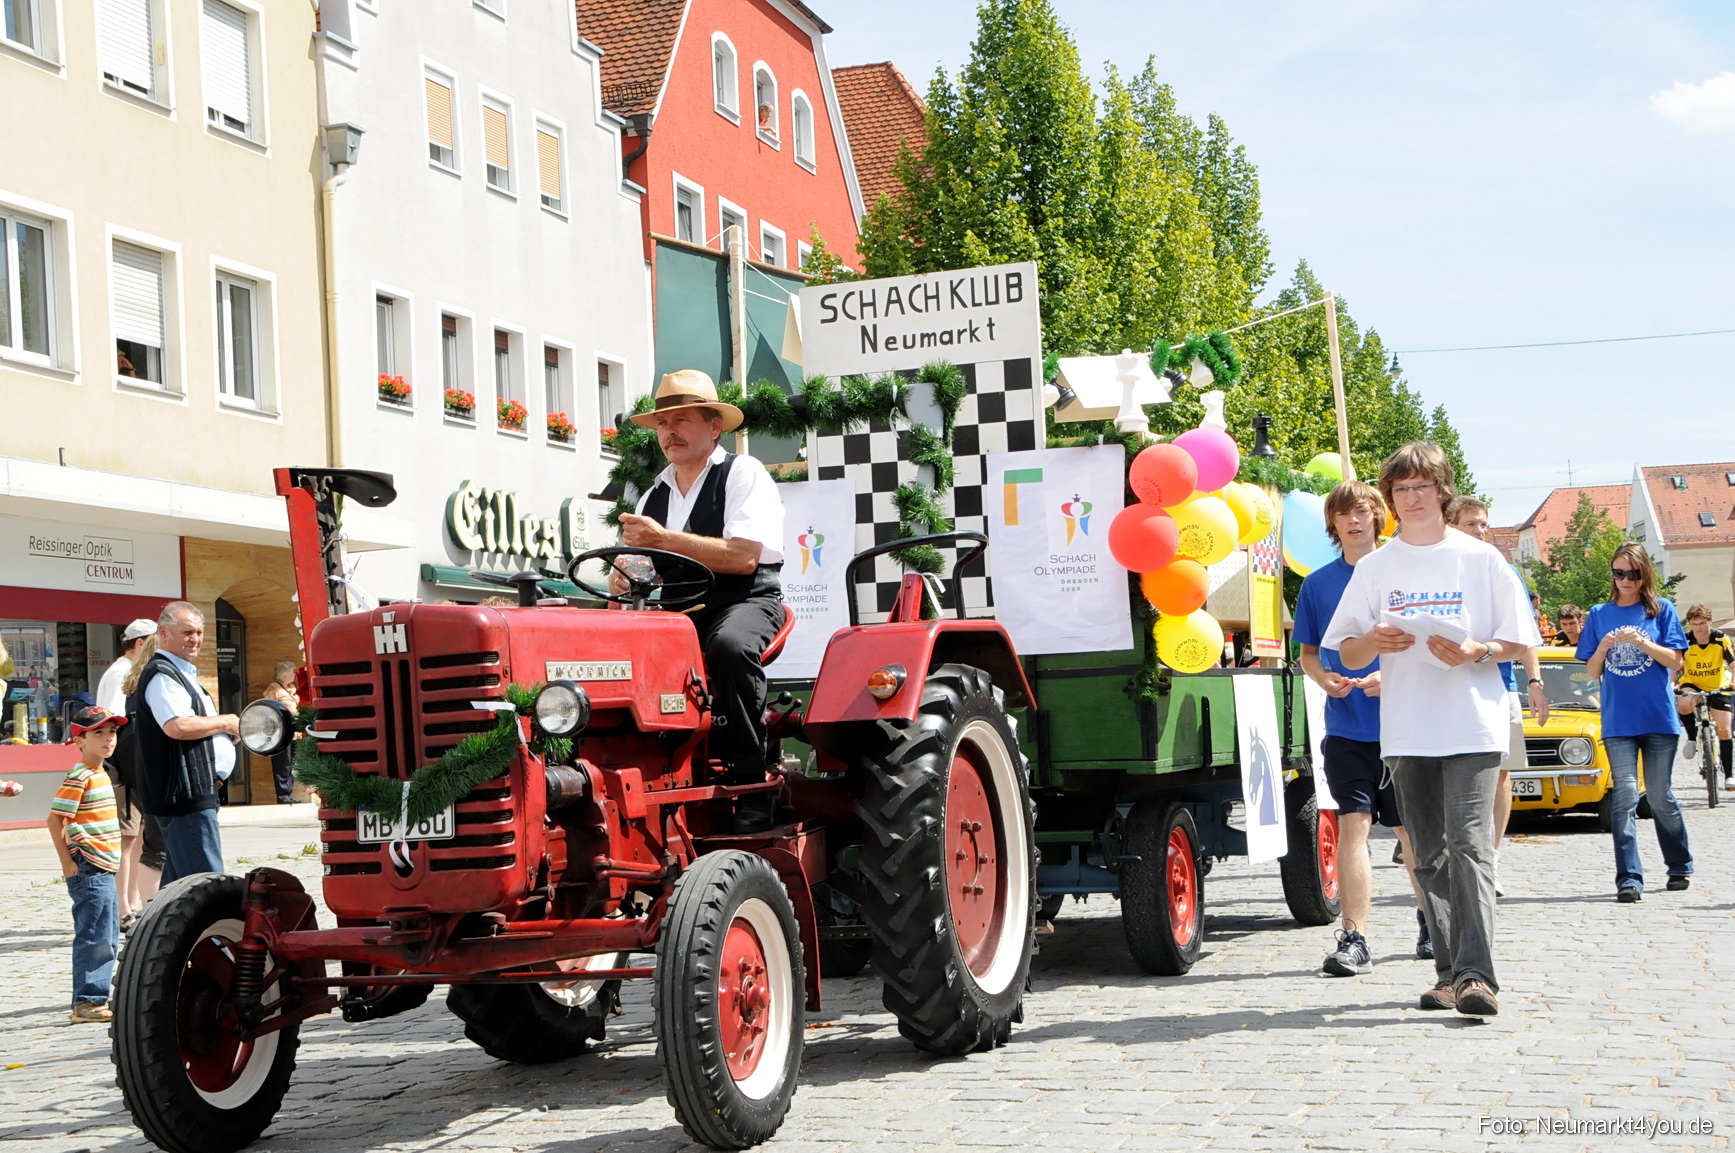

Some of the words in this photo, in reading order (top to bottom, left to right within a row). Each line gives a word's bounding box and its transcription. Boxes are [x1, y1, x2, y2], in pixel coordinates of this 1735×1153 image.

[861, 317, 996, 354] Neumarkt
[29, 535, 83, 557] Reissinger
[86, 541, 113, 559] Optik
[1050, 554, 1096, 563] SCHACH
[87, 564, 133, 580] CENTRUM
[1034, 565, 1096, 575] OLYMPIADE
[787, 584, 828, 592] SCHACH
[783, 595, 828, 603] LYMPIADE
[1696, 661, 1713, 669] BAU
